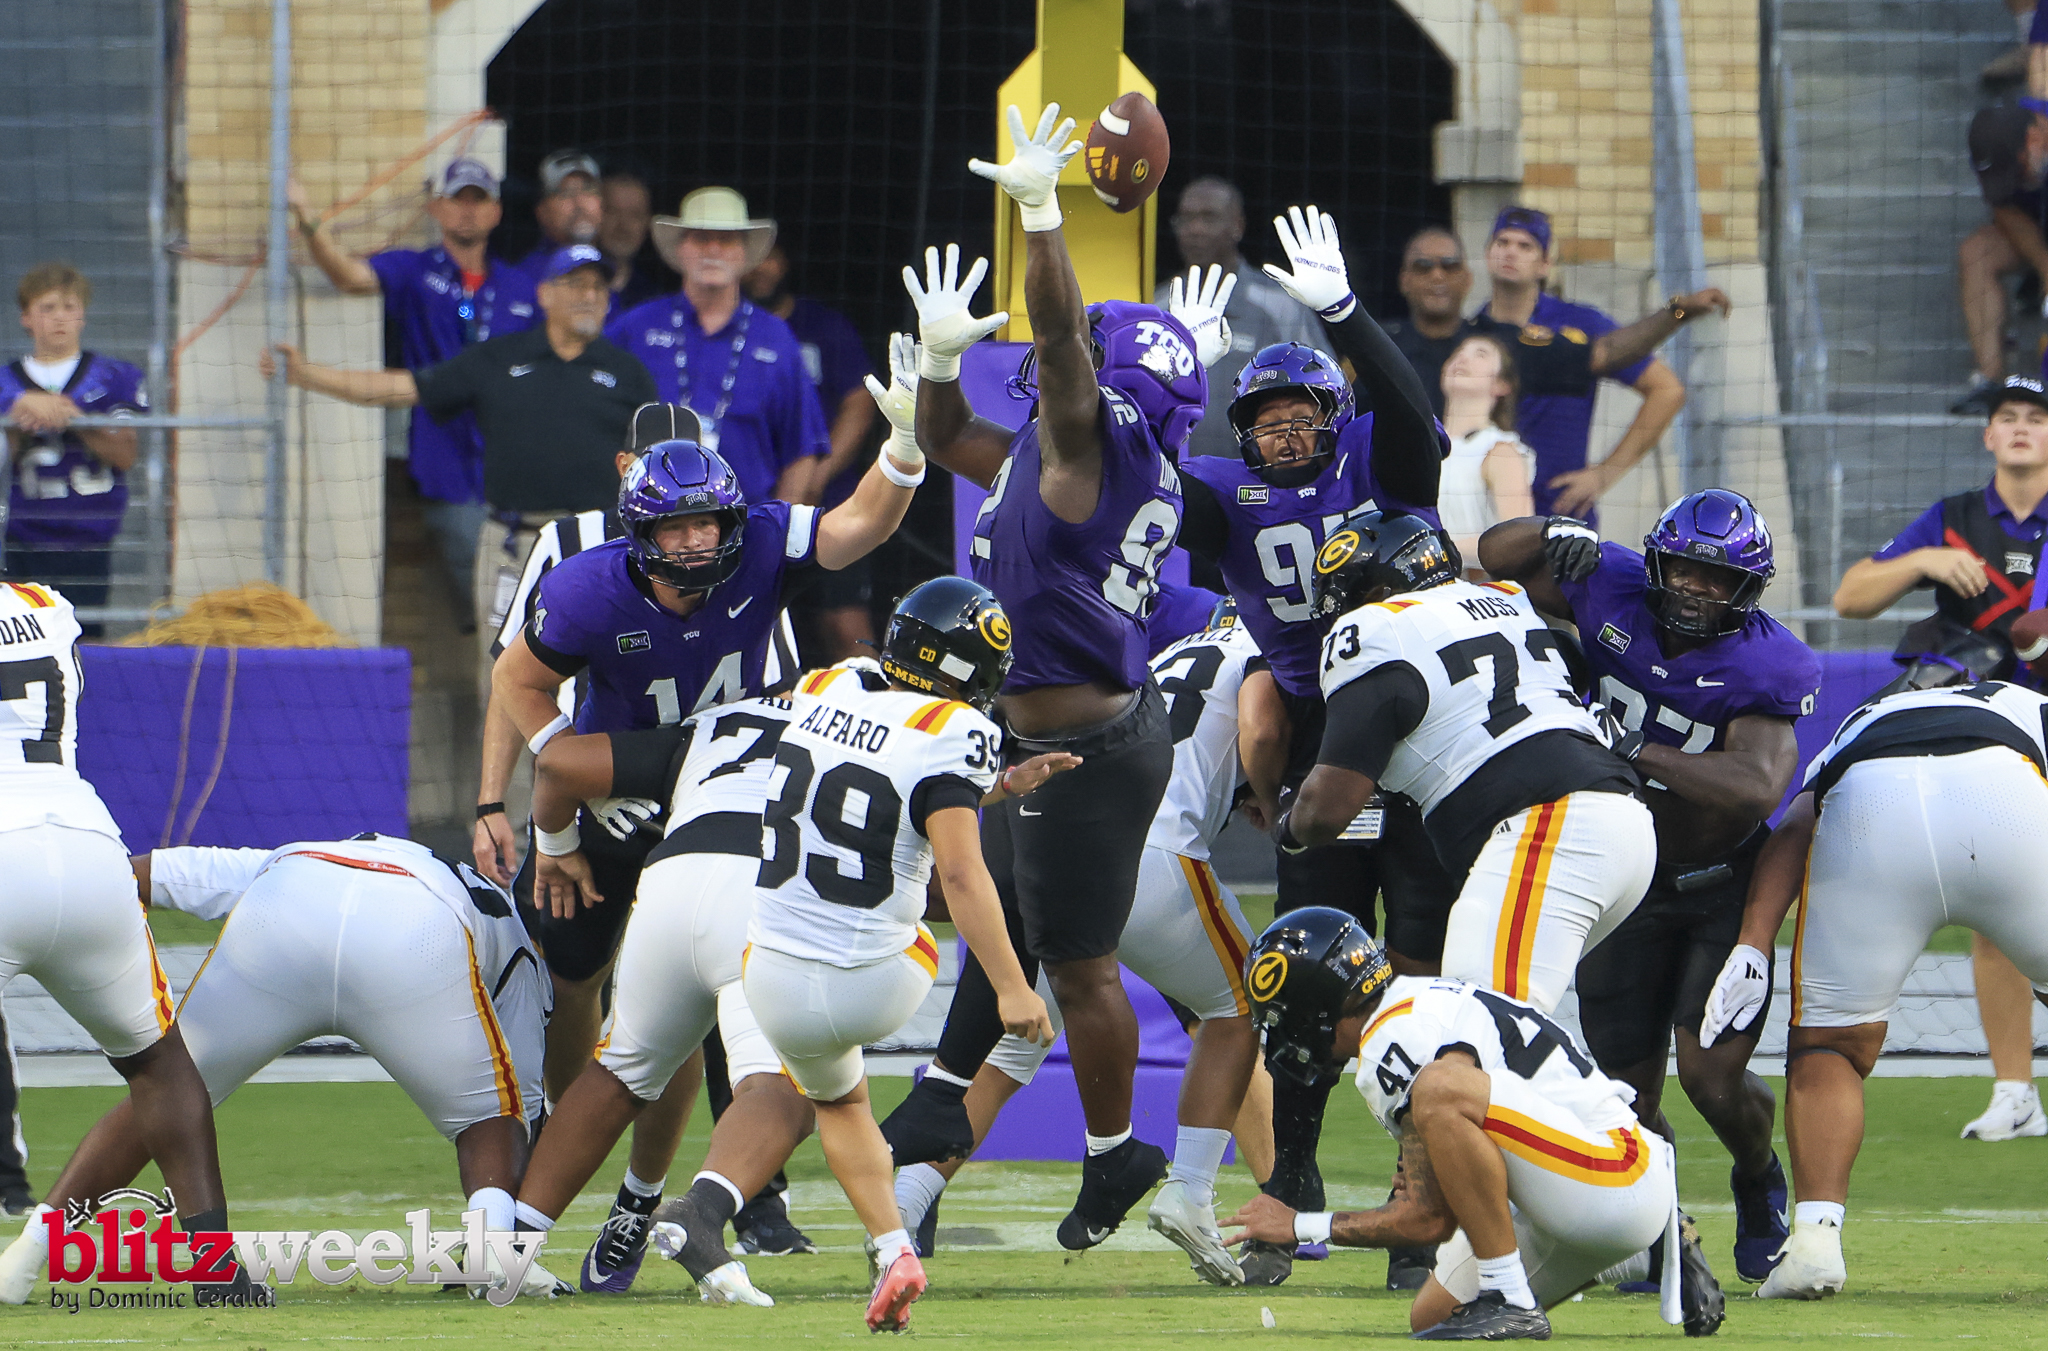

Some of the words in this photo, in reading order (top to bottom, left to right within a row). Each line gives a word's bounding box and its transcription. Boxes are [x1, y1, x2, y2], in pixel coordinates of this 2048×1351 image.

[1294, 256, 1319, 268] HORNED
[1319, 264, 1341, 274] FROGS
[1198, 315, 1219, 330] FROGS
[1134, 321, 1196, 377] TCU
[1256, 369, 1278, 382] TCU
[686, 492, 708, 506] TCU
[1298, 487, 1317, 498] TCU
[1695, 543, 1718, 557] TCU
[1456, 596, 1520, 622] MOSS
[1219, 616, 1235, 628] CD
[683, 630, 701, 641] TCU
[919, 646, 937, 663] CD
[1323, 623, 1362, 673] 73
[1651, 665, 1669, 679] TCU
[645, 651, 748, 730] 14
[798, 704, 890, 754] ALFARO
[755, 741, 903, 910] 39
[1248, 952, 1289, 1002] G
[1375, 1042, 1420, 1097] 47
